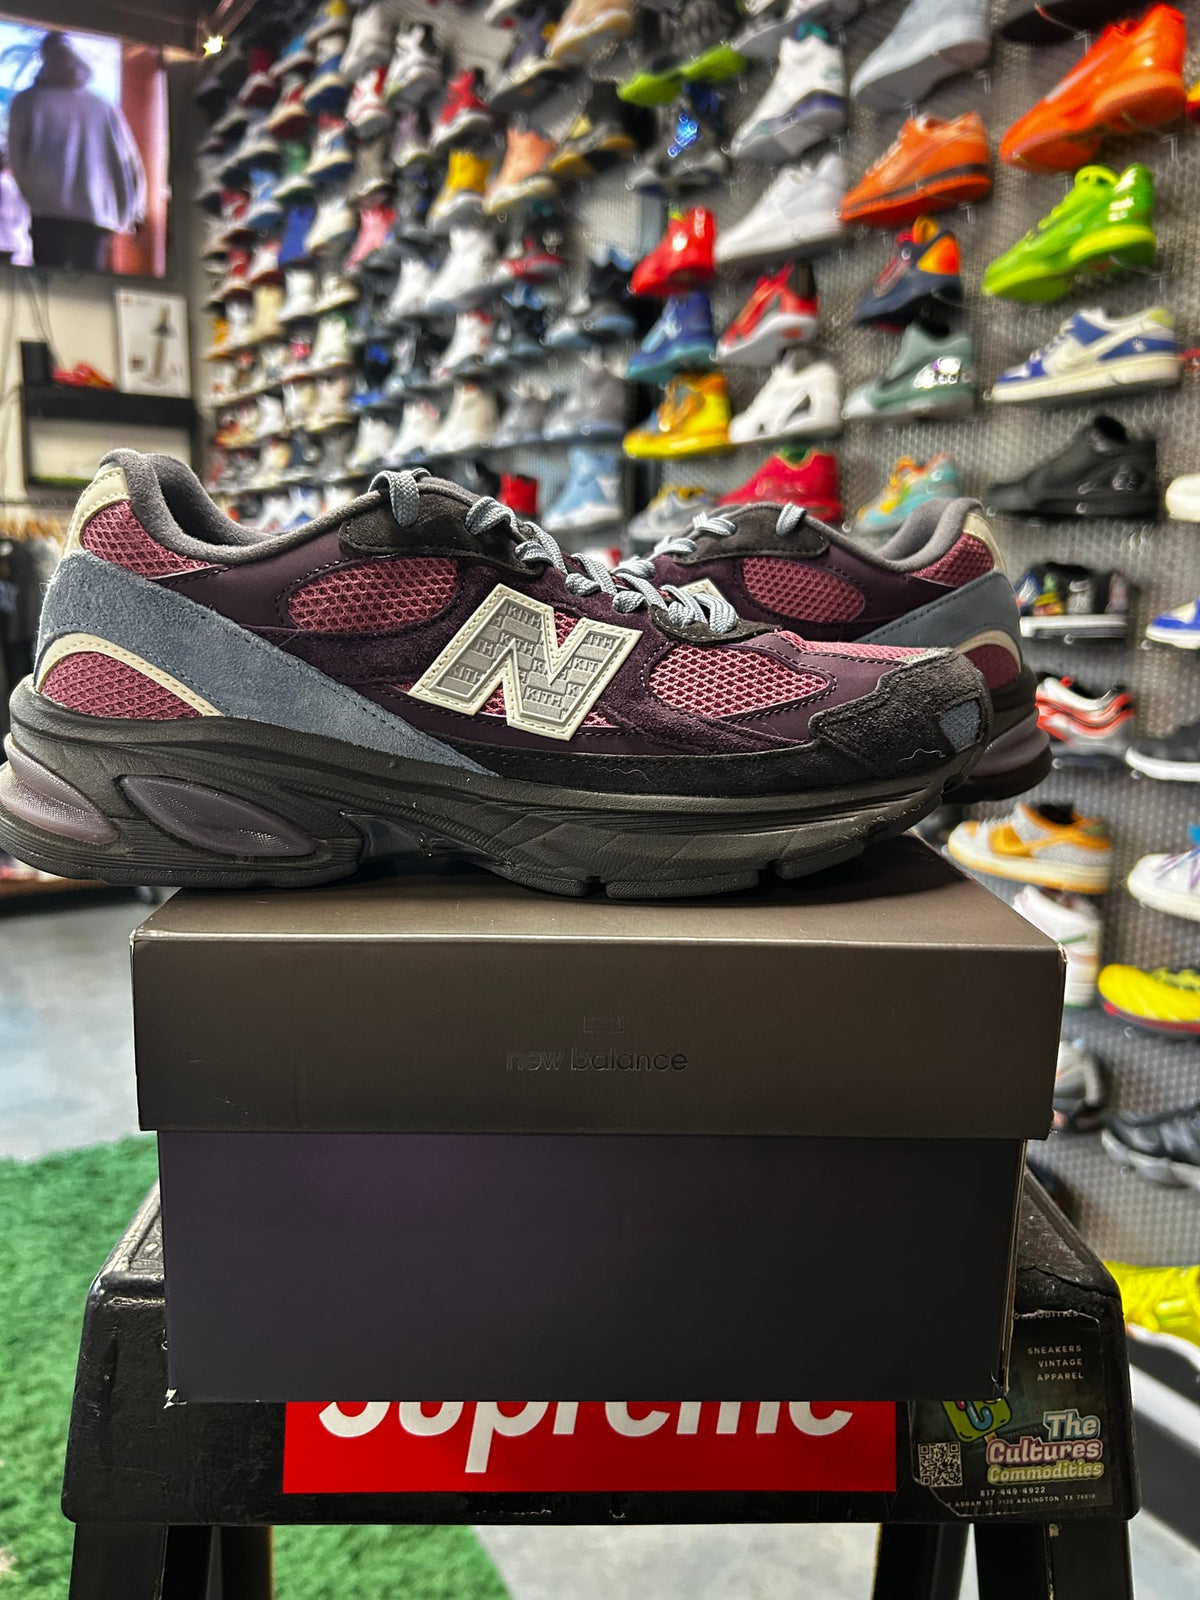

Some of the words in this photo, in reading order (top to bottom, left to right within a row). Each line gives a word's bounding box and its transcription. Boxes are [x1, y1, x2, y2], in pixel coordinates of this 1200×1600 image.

[508, 605, 542, 629] KITH
[574, 658, 599, 673] KIT
[526, 688, 563, 707] KITH
[506, 1051, 564, 1071] new
[571, 1047, 688, 1072] balance
[1027, 1345, 1083, 1355] SNEAKERS
[1038, 1358, 1083, 1368] VINTAGE
[1037, 1372, 1084, 1382] APPAREL
[1045, 1411, 1099, 1439] The
[988, 1438, 1101, 1464] Cultures
[989, 1460, 1102, 1483] Commodities
